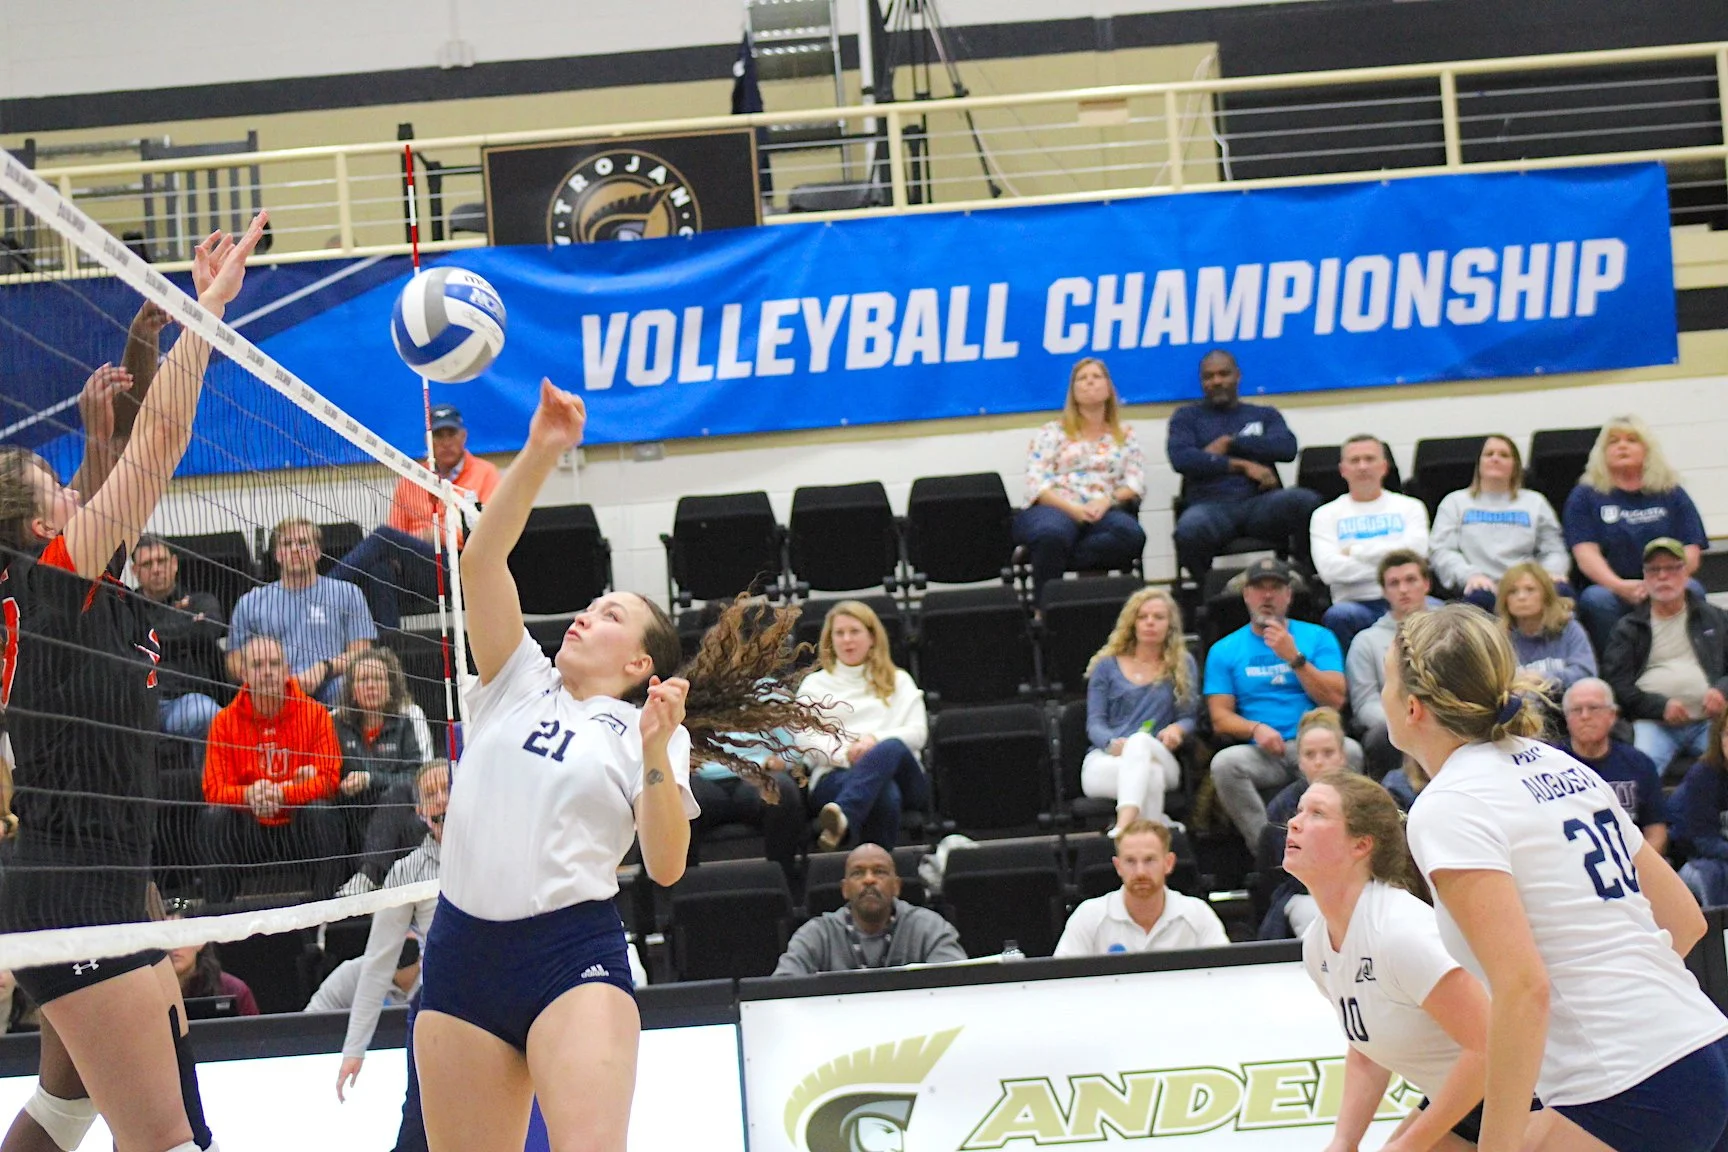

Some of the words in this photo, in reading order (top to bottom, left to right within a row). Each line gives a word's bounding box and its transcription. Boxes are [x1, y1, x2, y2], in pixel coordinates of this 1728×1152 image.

[554, 155, 691, 215] TROJAN
[581, 282, 1020, 391] VOLLEYBALL
[1042, 237, 1628, 355] CHAMPIONSHIP
[522, 720, 576, 762] 21
[1521, 766, 1597, 803] AUGUSTA
[1563, 808, 1640, 901] 20
[1340, 996, 1369, 1041] 10
[956, 1054, 1426, 1152] ANDE
